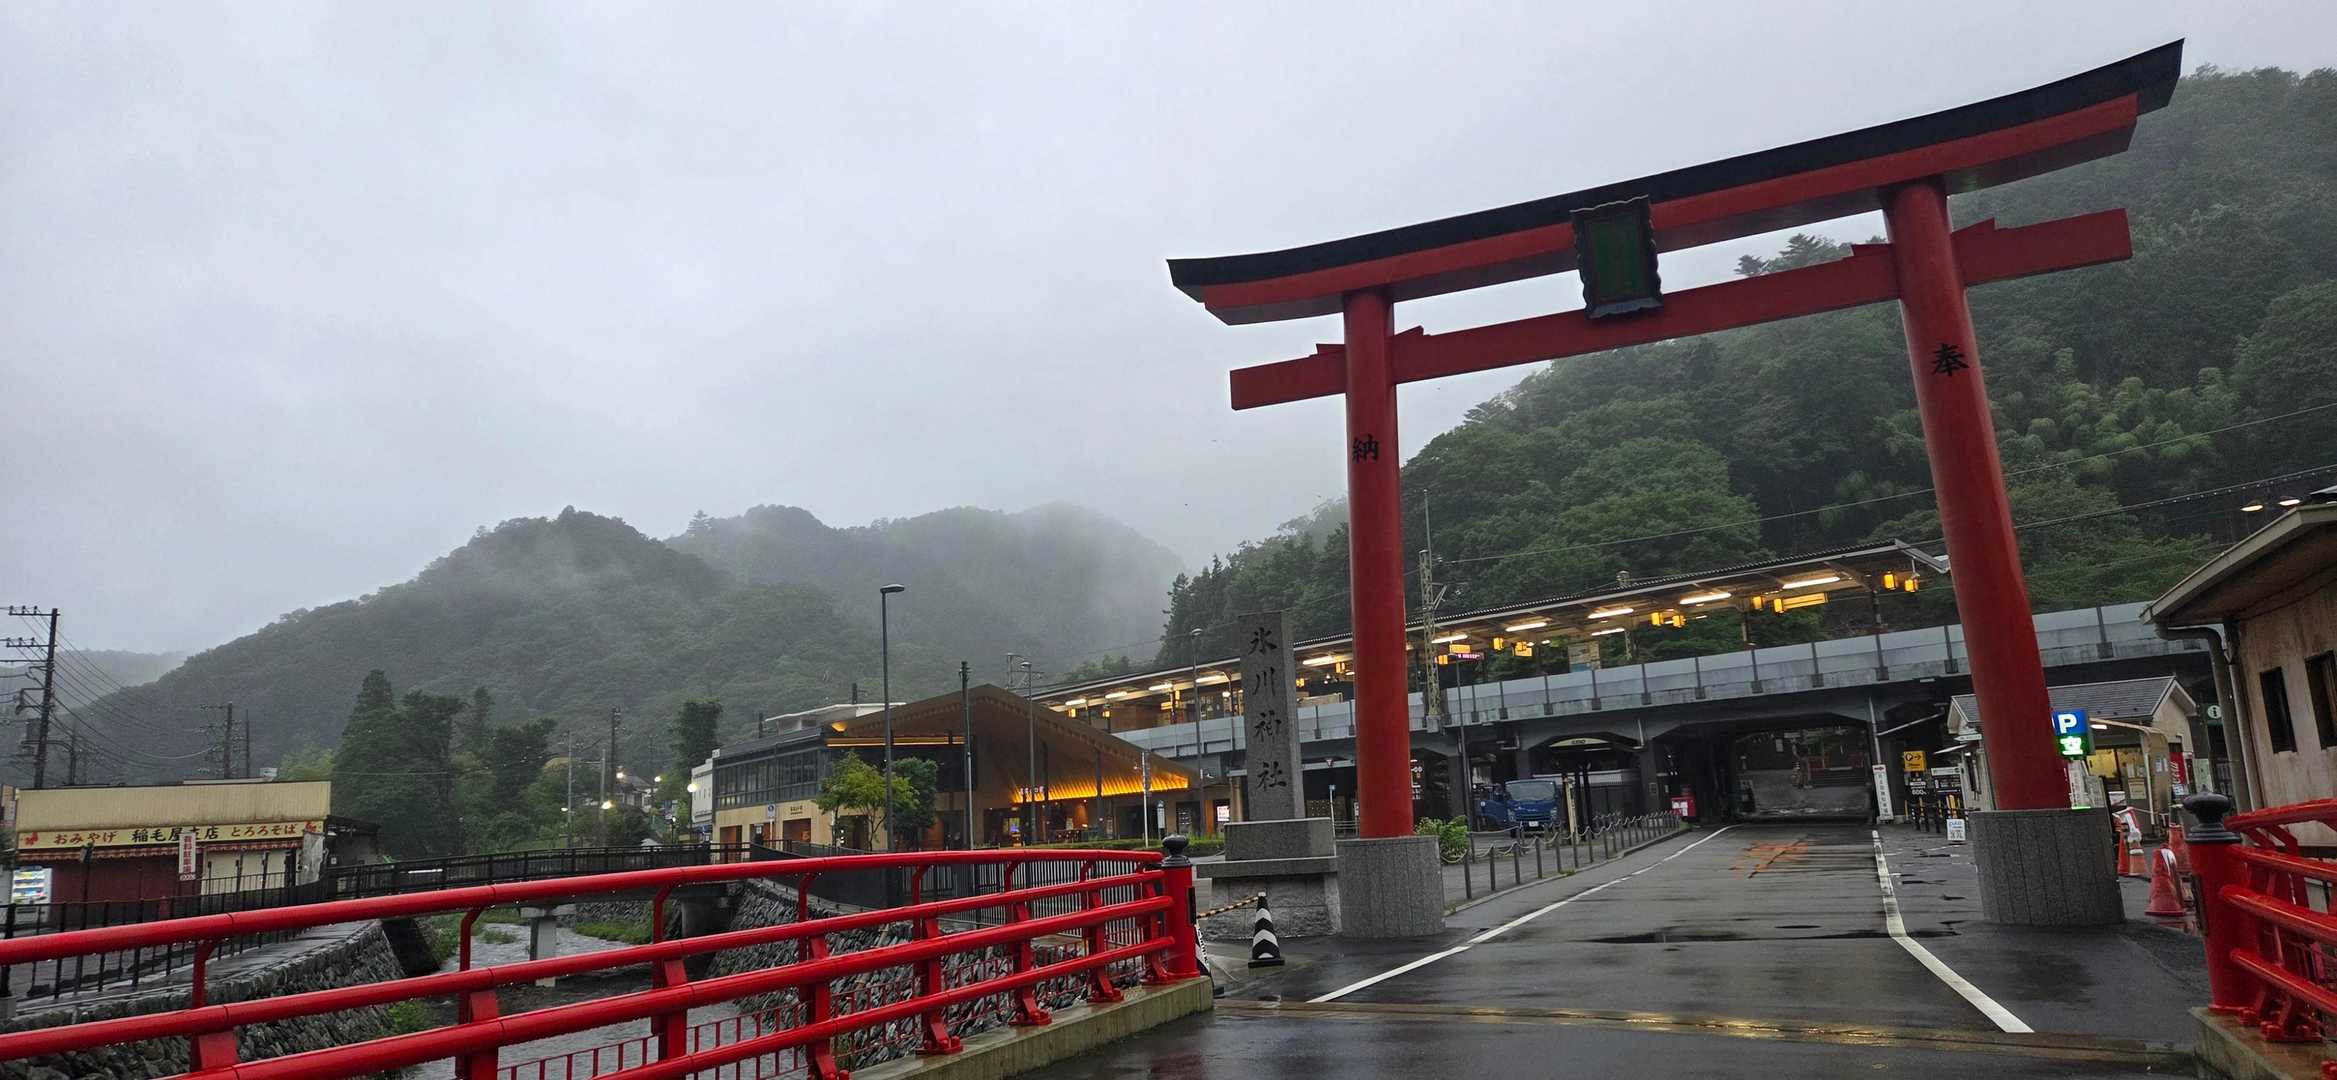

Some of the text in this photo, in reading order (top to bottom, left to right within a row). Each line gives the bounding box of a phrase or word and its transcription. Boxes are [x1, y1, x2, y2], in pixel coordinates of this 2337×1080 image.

[1930, 343, 1969, 377] 奉
[1352, 433, 1378, 464] 納
[1250, 627, 1287, 791] 氷川神社
[2058, 713, 2077, 734] P
[54, 830, 117, 845] おみやげ
[231, 823, 297, 837] とろろそば
